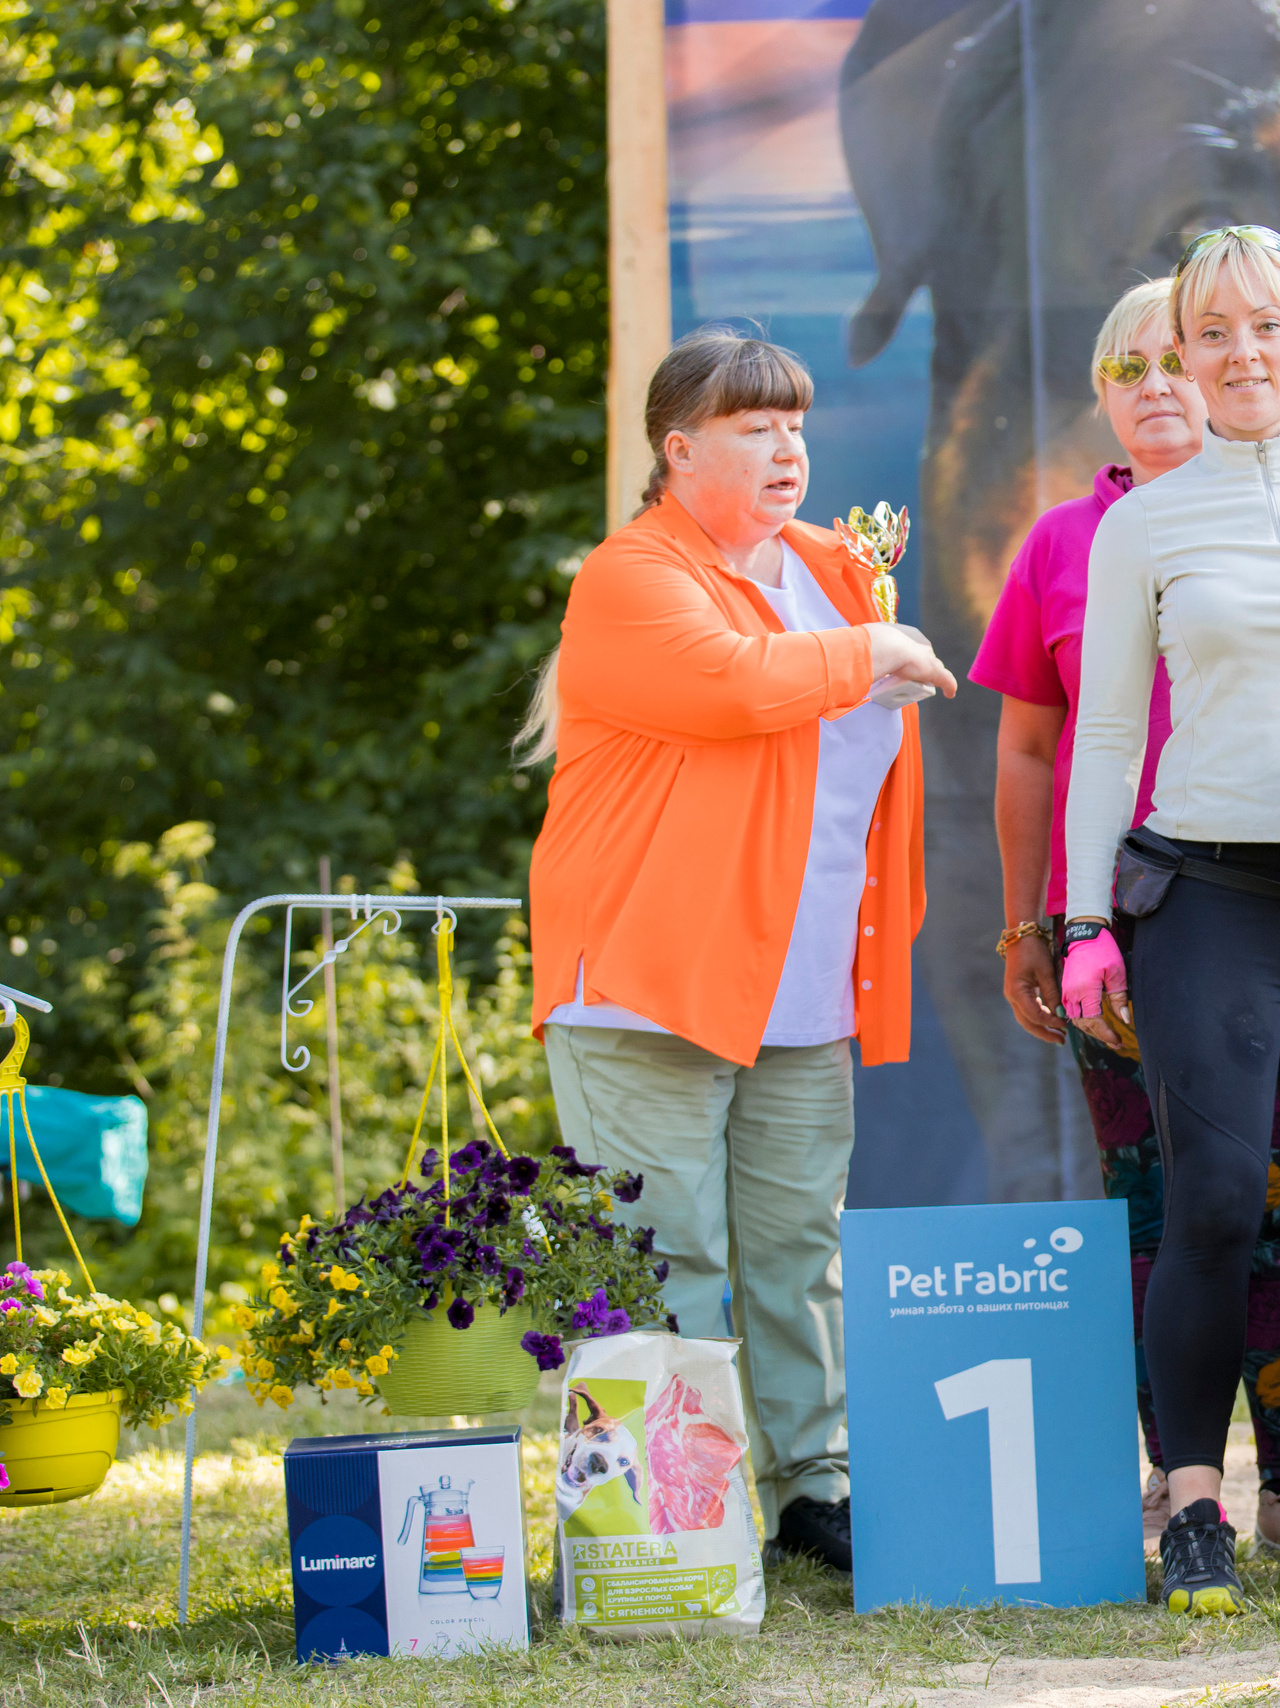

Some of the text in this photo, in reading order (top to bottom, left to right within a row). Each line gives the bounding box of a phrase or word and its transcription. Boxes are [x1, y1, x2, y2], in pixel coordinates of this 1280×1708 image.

[889, 1300, 1069, 1318] умная забота о ваших питомцах
[934, 1358, 1041, 1585] 1
[587, 1540, 677, 1560] STATERA
[301, 1554, 376, 1572] Luminarc
[615, 1558, 661, 1567] BALANCE
[607, 1583, 694, 1596] ДЛЯ ВЗРОСЛЫХ СОБАК
[607, 1596, 643, 1604] КРУПНЫХ
[608, 1606, 675, 1618] С ЯГНЕНКОМ
[409, 1638, 418, 1651] 7
